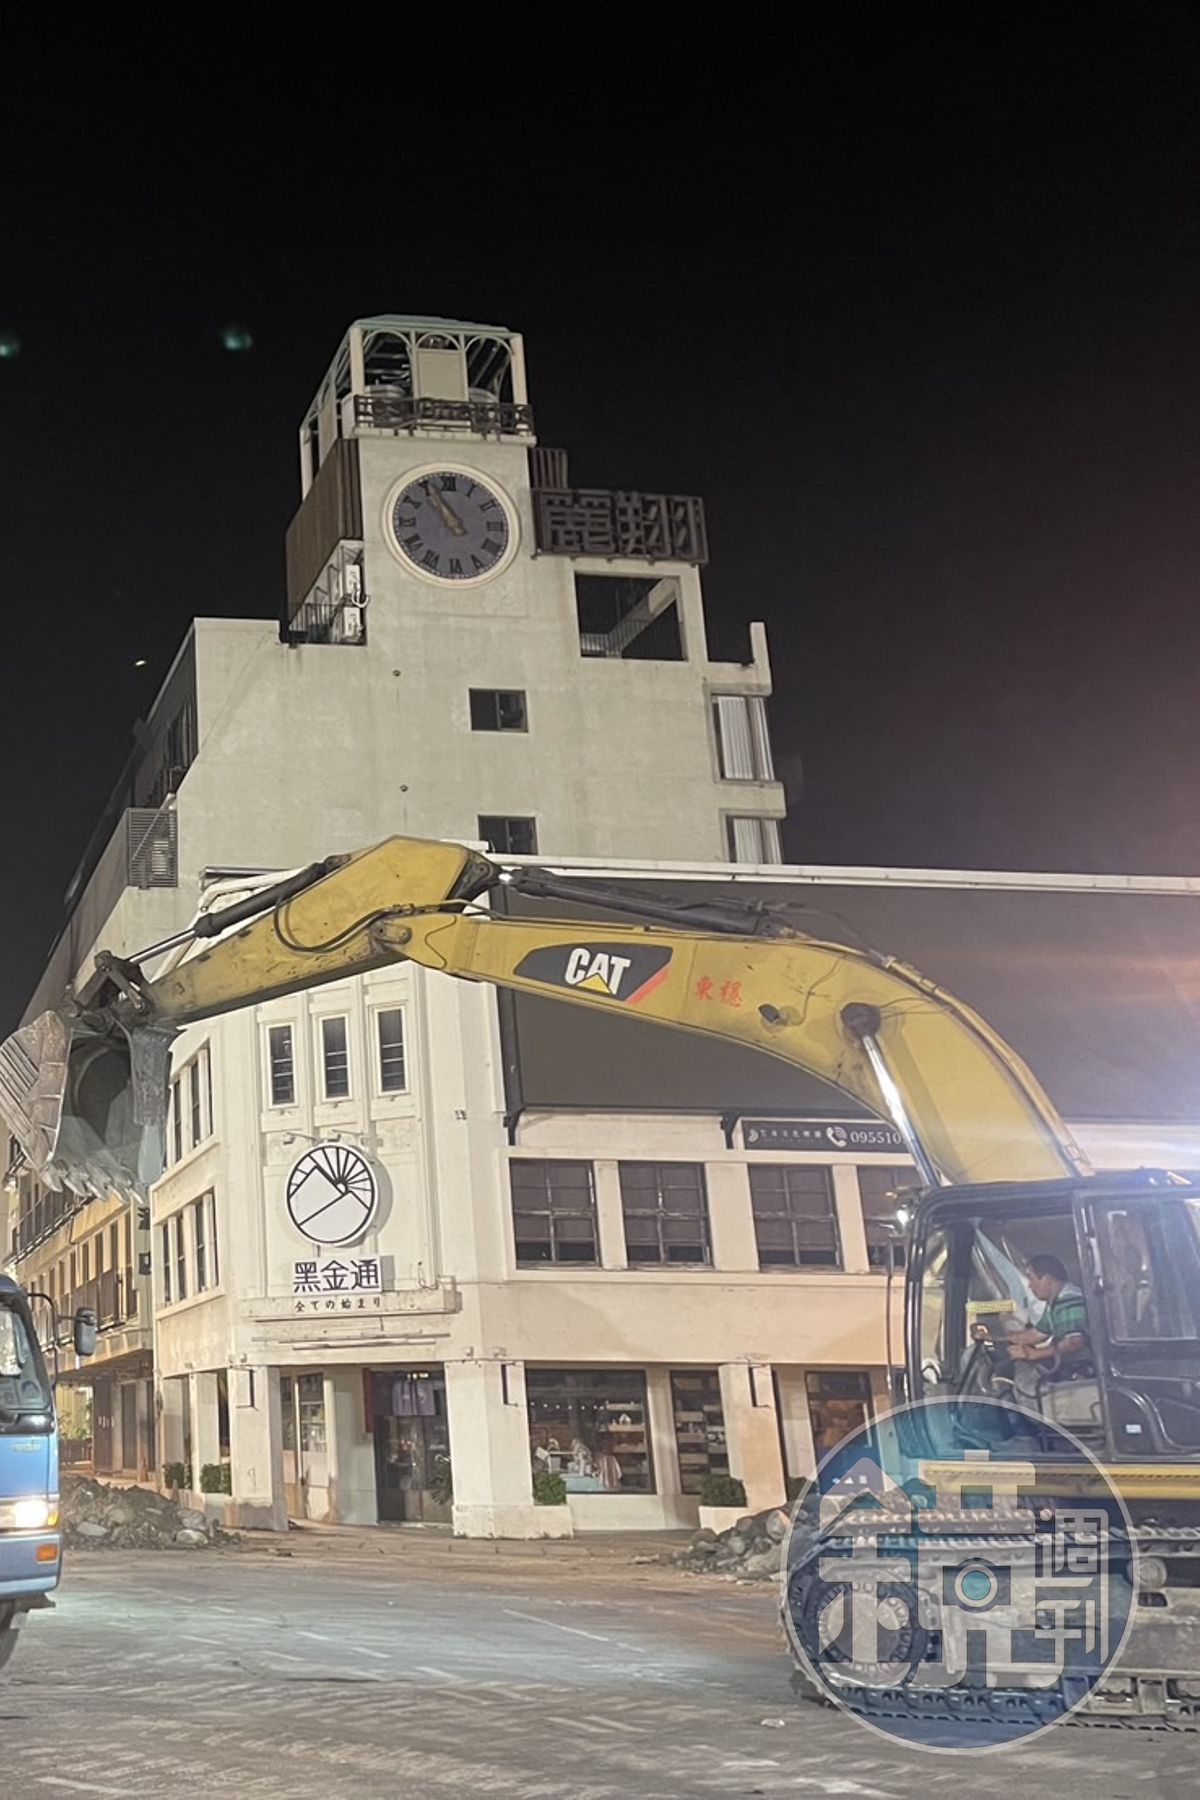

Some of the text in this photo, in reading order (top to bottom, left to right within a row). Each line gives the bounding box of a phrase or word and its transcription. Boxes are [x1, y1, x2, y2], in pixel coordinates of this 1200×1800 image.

[564, 947, 631, 996] CAT
[849, 1131, 907, 1145] 095510
[293, 1259, 380, 1293] 黑金通
[294, 1297, 381, 1313] 全ての始まり
